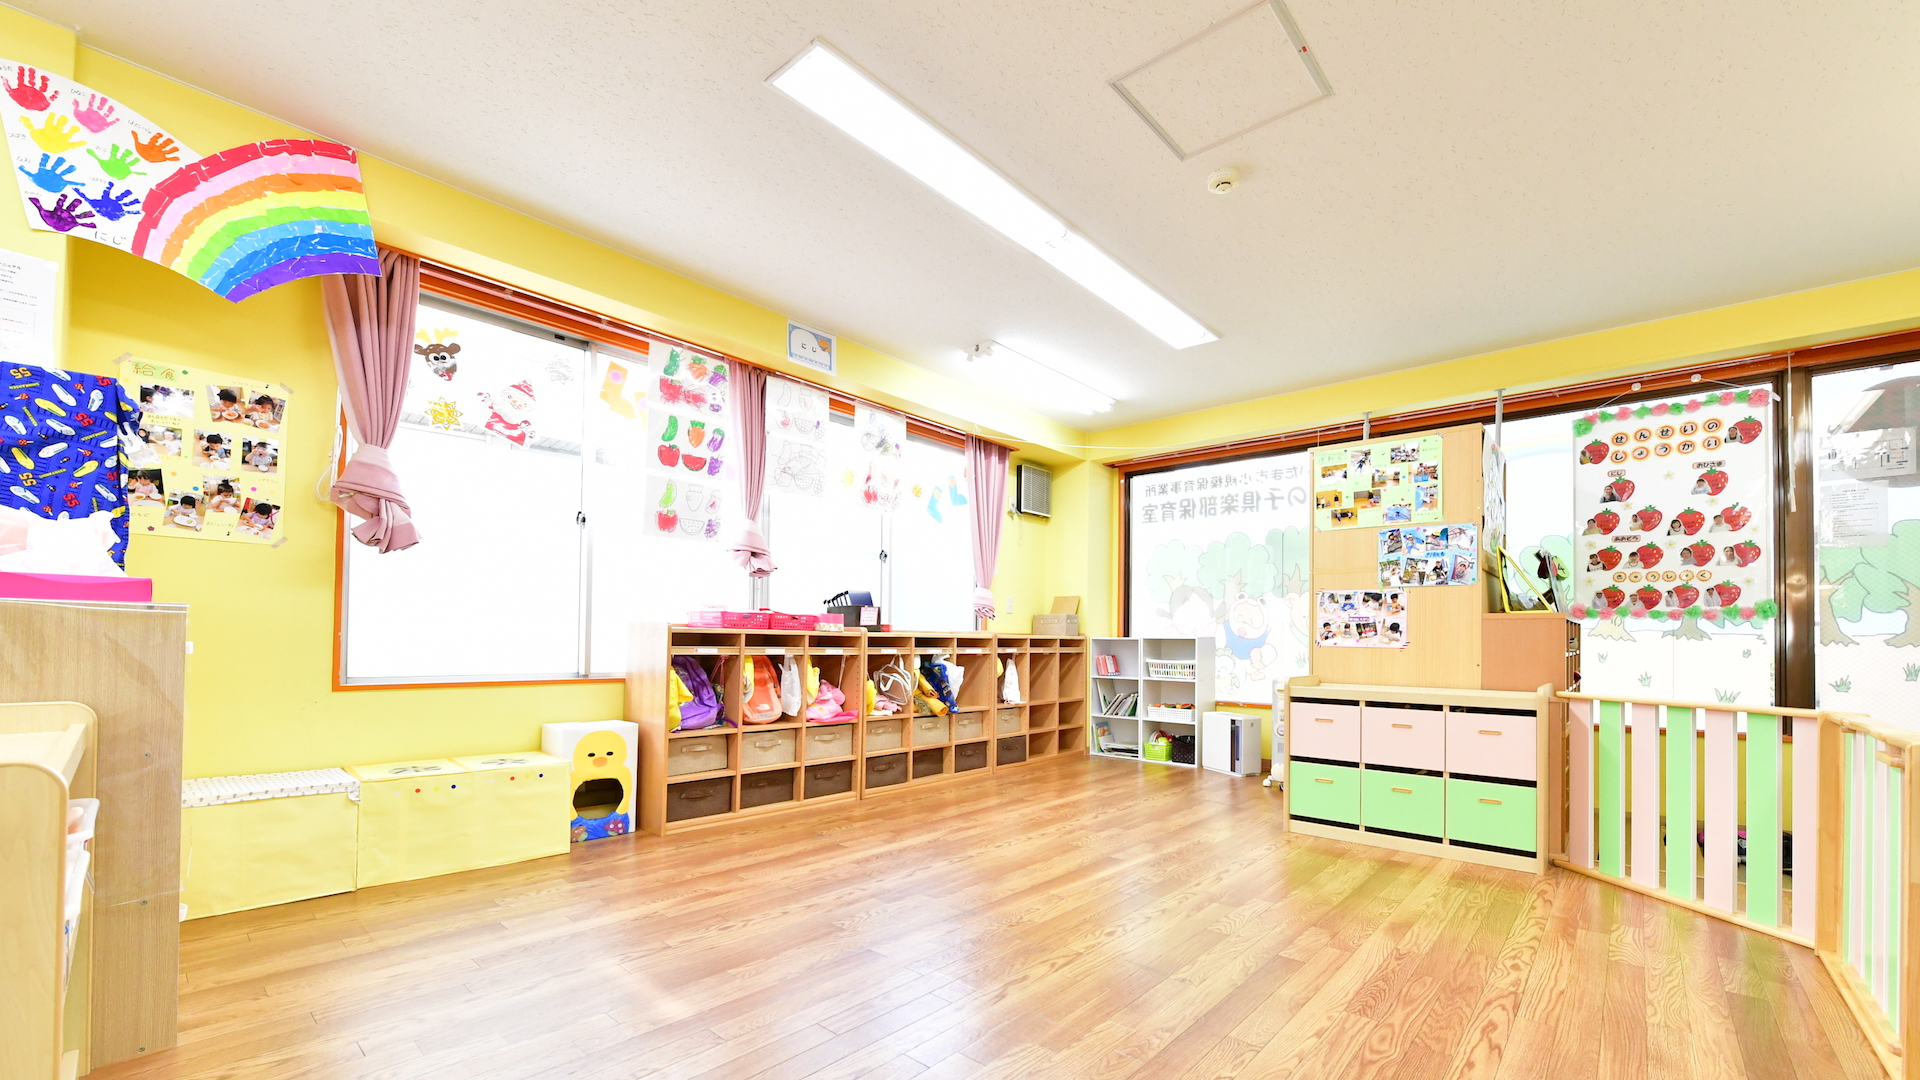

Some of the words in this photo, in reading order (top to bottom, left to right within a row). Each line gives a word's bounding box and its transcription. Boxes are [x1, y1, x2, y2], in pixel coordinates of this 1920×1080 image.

[94, 230, 127, 246] にじ
[801, 342, 817, 353] にじ
[1615, 421, 1718, 444] せんせいの
[1615, 439, 1718, 460] しょうかい
